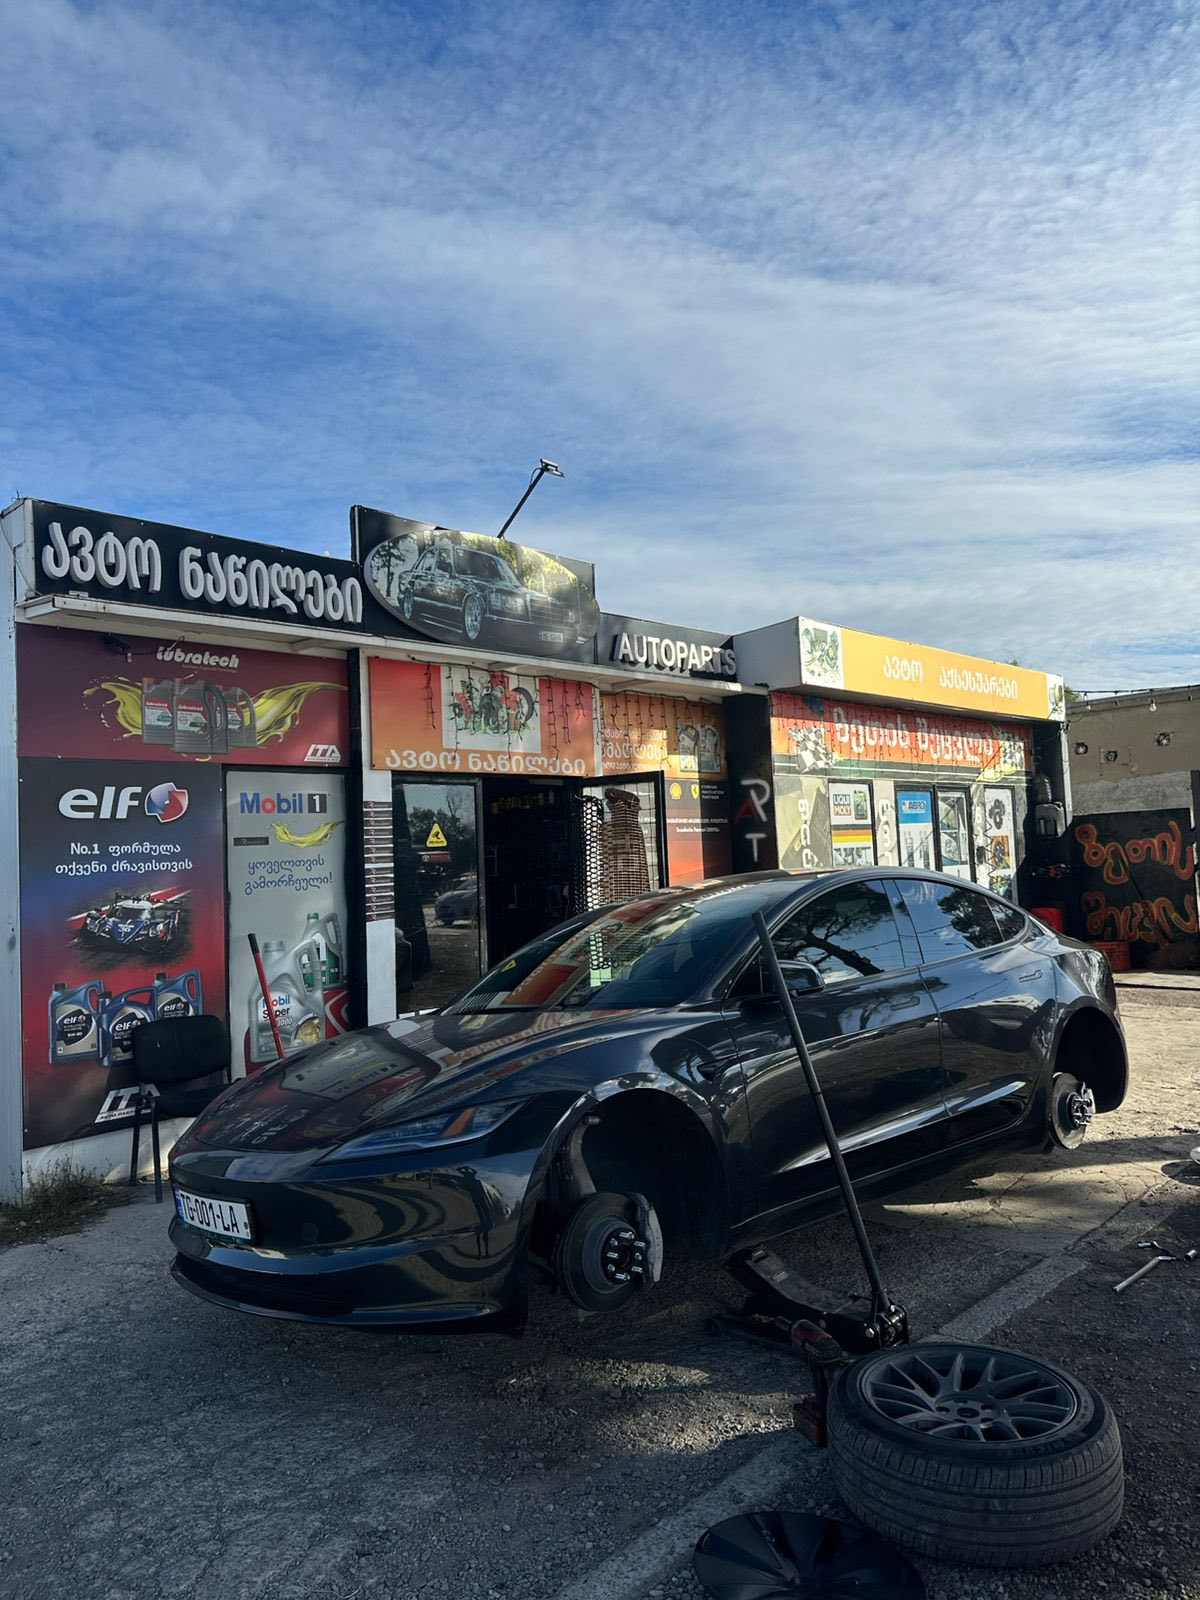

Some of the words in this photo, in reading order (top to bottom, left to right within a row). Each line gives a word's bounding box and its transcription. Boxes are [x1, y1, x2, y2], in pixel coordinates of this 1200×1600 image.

[42, 522, 162, 592] ავტო
[179, 546, 363, 624] ნაწილები
[615, 632, 737, 675] AUTOPARTS
[883, 655, 923, 682] ავტო
[940, 665, 1018, 699] აქსესუარები
[833, 706, 910, 753] ზეთის
[385, 749, 461, 769] ავტო
[468, 753, 586, 775] ნაწილები
[58, 786, 142, 819] elf
[240, 793, 303, 814] Mobil
[70, 843, 100, 855] No.1
[108, 842, 181, 855] ფორმულა
[1075, 820, 1193, 885] ზეთის
[55, 861, 107, 876] თქვენი
[112, 858, 193, 873] ძრავისთვის
[248, 854, 325, 875] ყოველთვის
[244, 872, 333, 896] გამორჩეული!
[164, 1003, 177, 1011] elf
[262, 1007, 290, 1019] Sper
[63, 1017, 78, 1025] elf
[115, 1021, 132, 1031] elf
[180, 1193, 240, 1234] TG-001-LA
